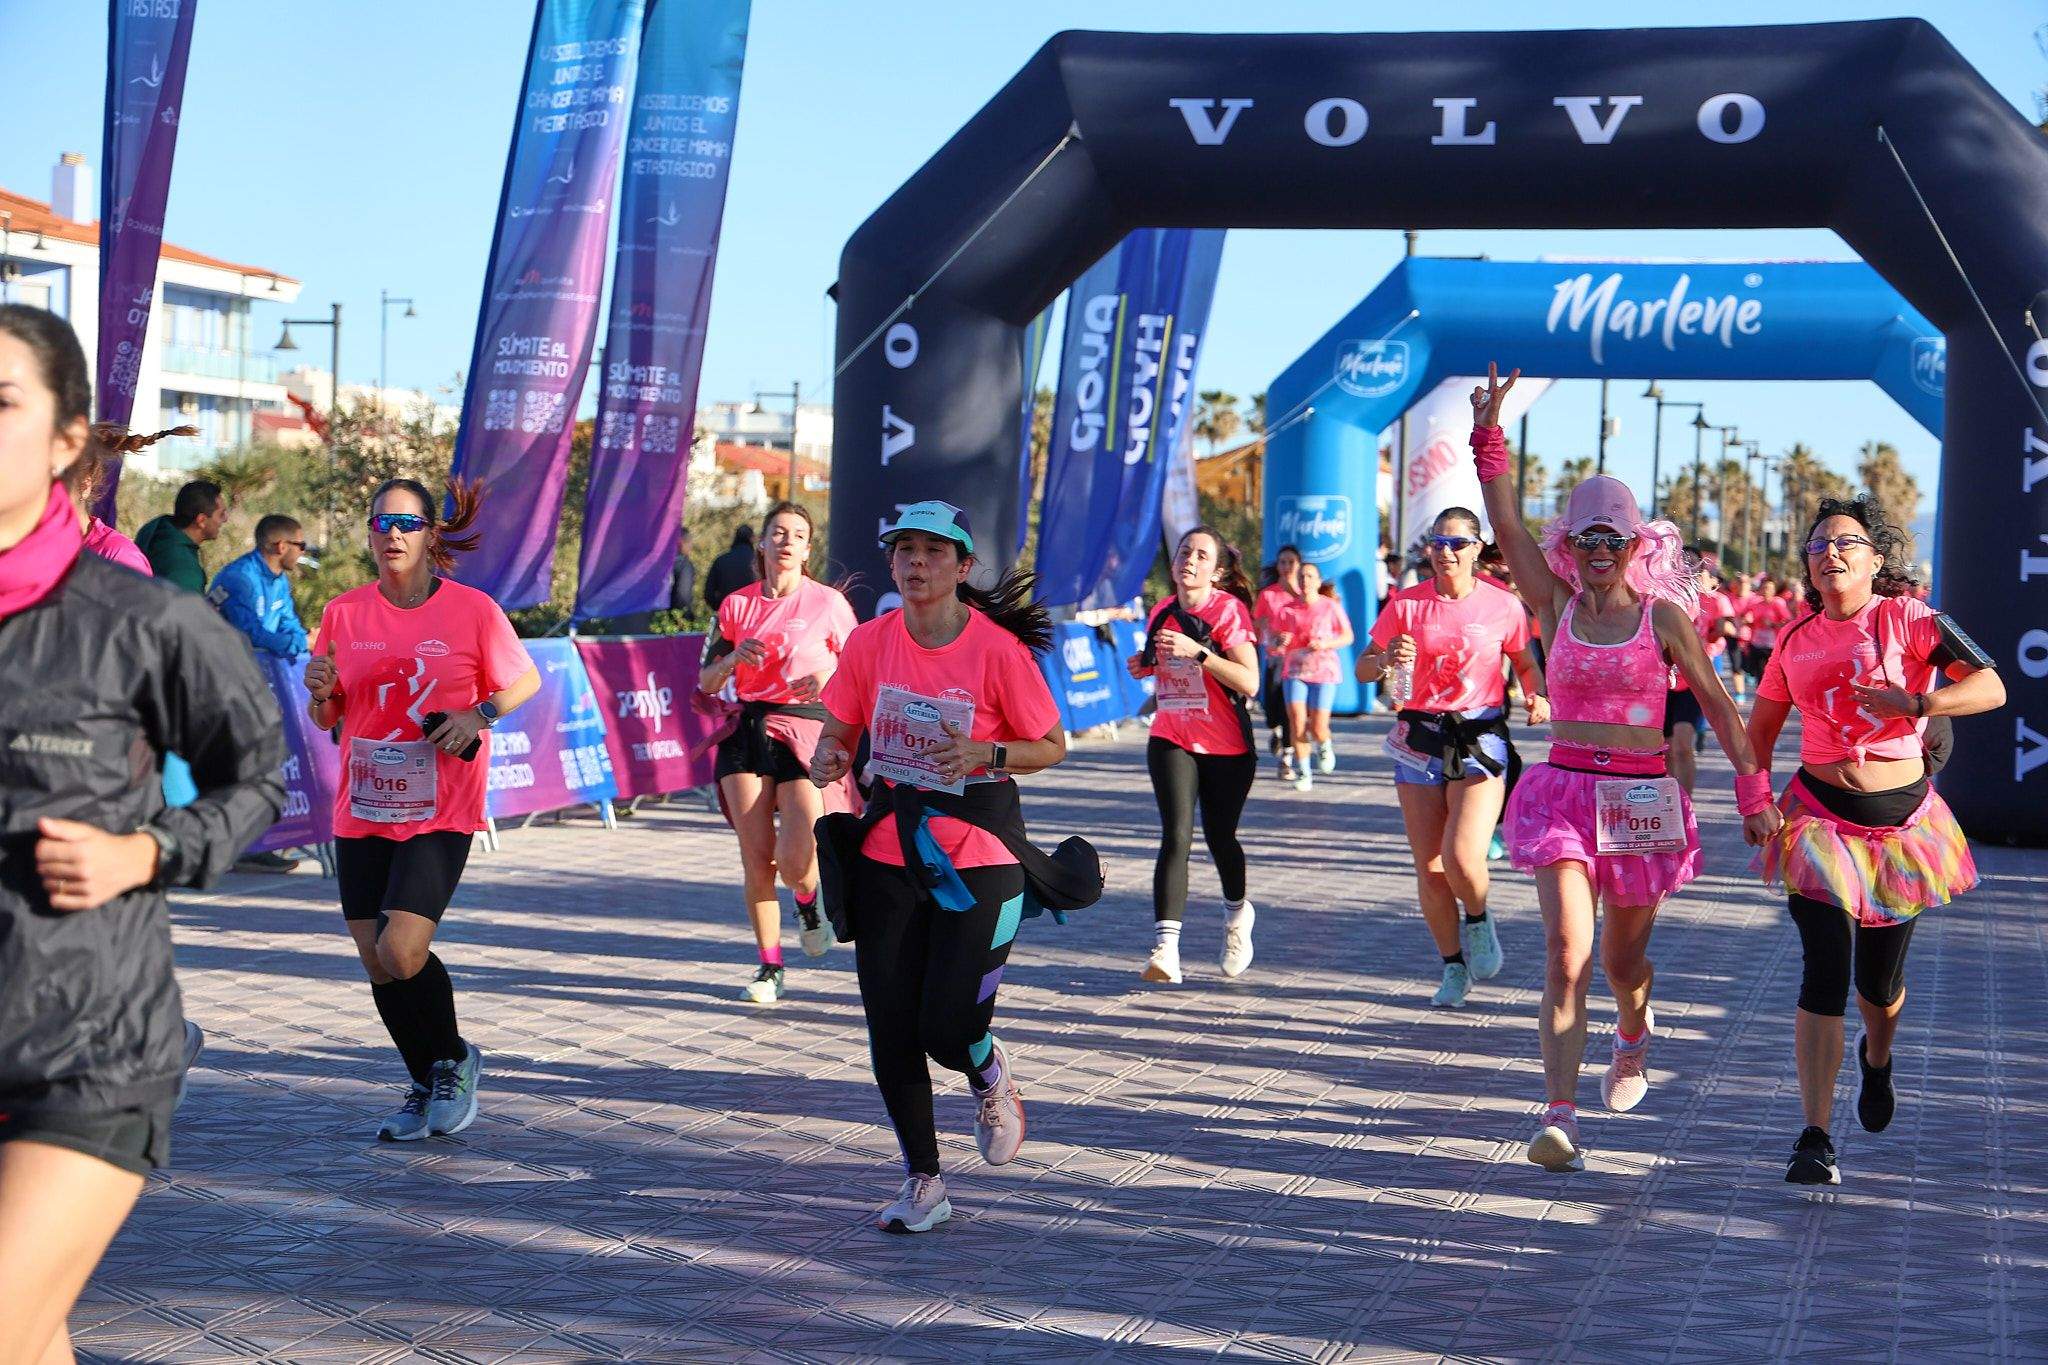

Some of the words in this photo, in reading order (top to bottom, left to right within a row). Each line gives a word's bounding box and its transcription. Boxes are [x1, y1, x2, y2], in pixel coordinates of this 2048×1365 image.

[1169, 92, 1767, 147] VOLVO
[1546, 272, 1764, 366] Marlene
[497, 331, 552, 357] SÚMATE
[551, 342, 570, 359] AL
[492, 359, 569, 379] MOVIMIENTO
[608, 358, 667, 386] SÚMATE
[351, 641, 386, 651] OYSHO
[374, 777, 407, 792] 016
[1629, 816, 1661, 831] 016
